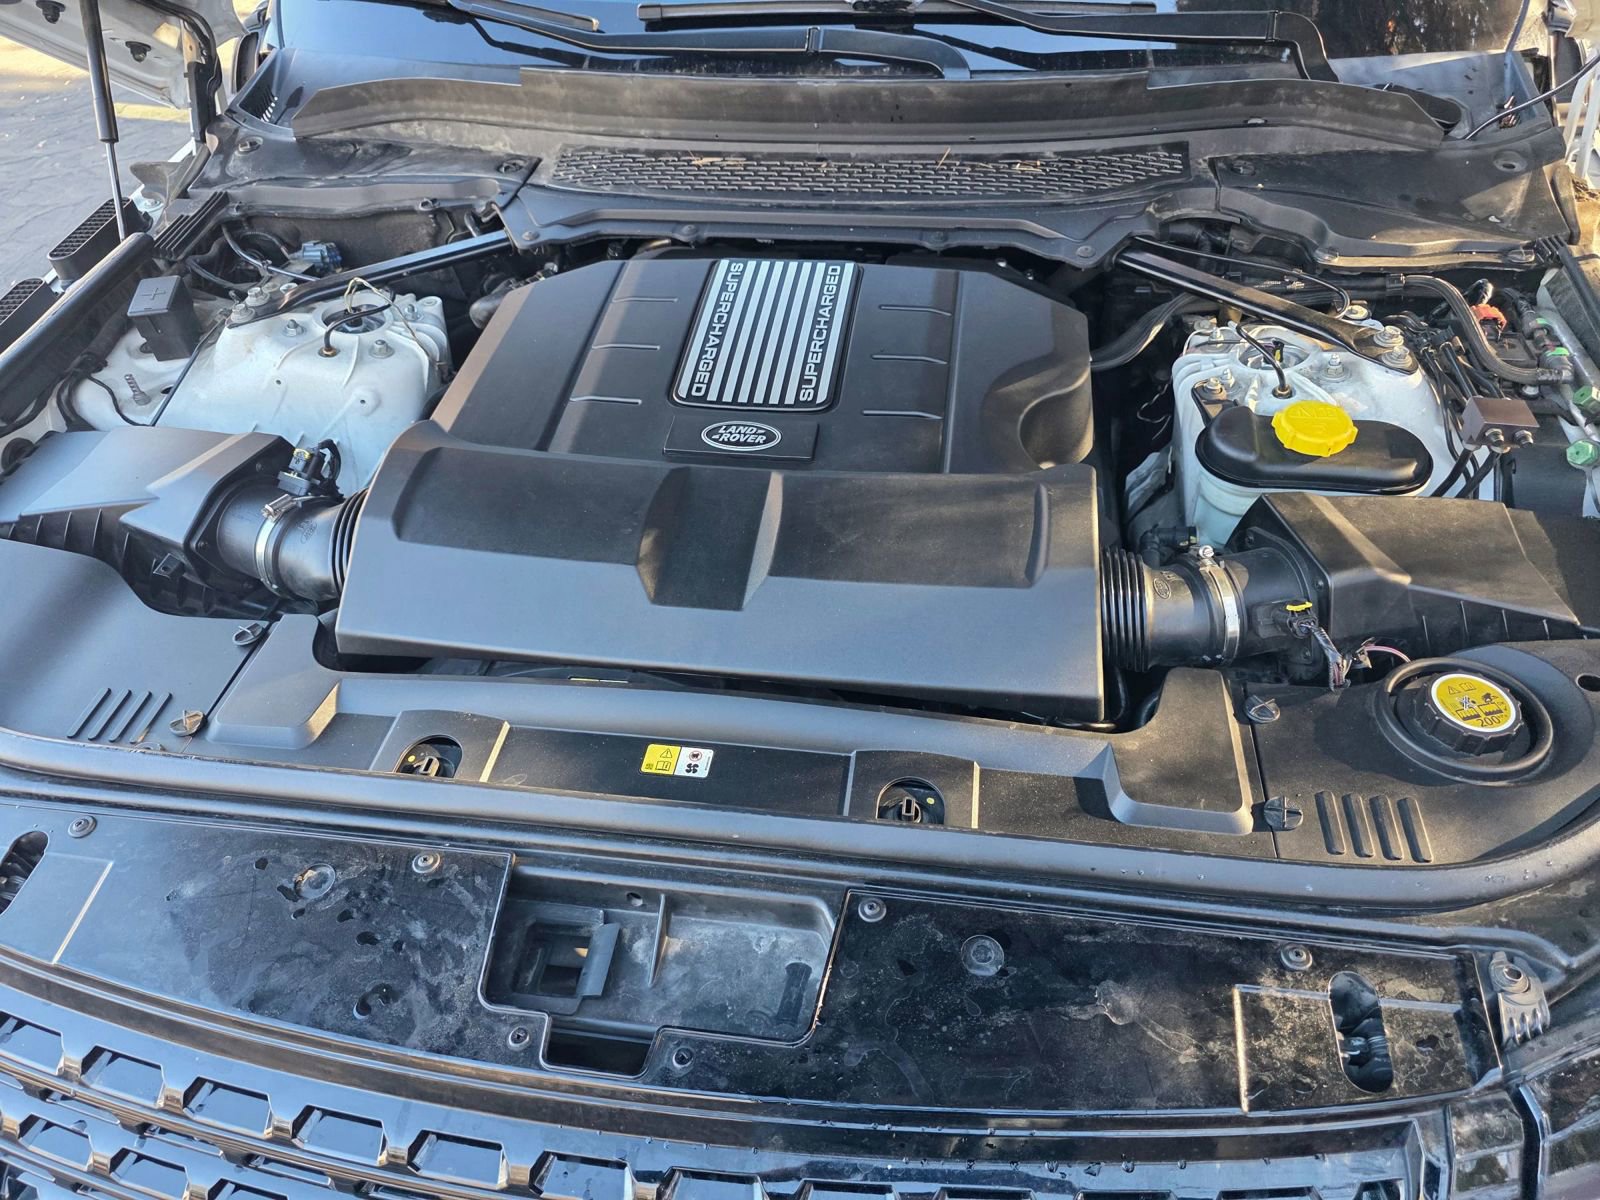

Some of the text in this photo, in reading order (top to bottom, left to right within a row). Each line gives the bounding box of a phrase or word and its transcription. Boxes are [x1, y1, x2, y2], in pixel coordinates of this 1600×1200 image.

[691, 262, 744, 397] SUPERCHARGED
[800, 265, 841, 401] SUPERCHARGED
[718, 425, 757, 434] LAND
[718, 433, 767, 444] ROVER
[1476, 715, 1501, 727] 200
